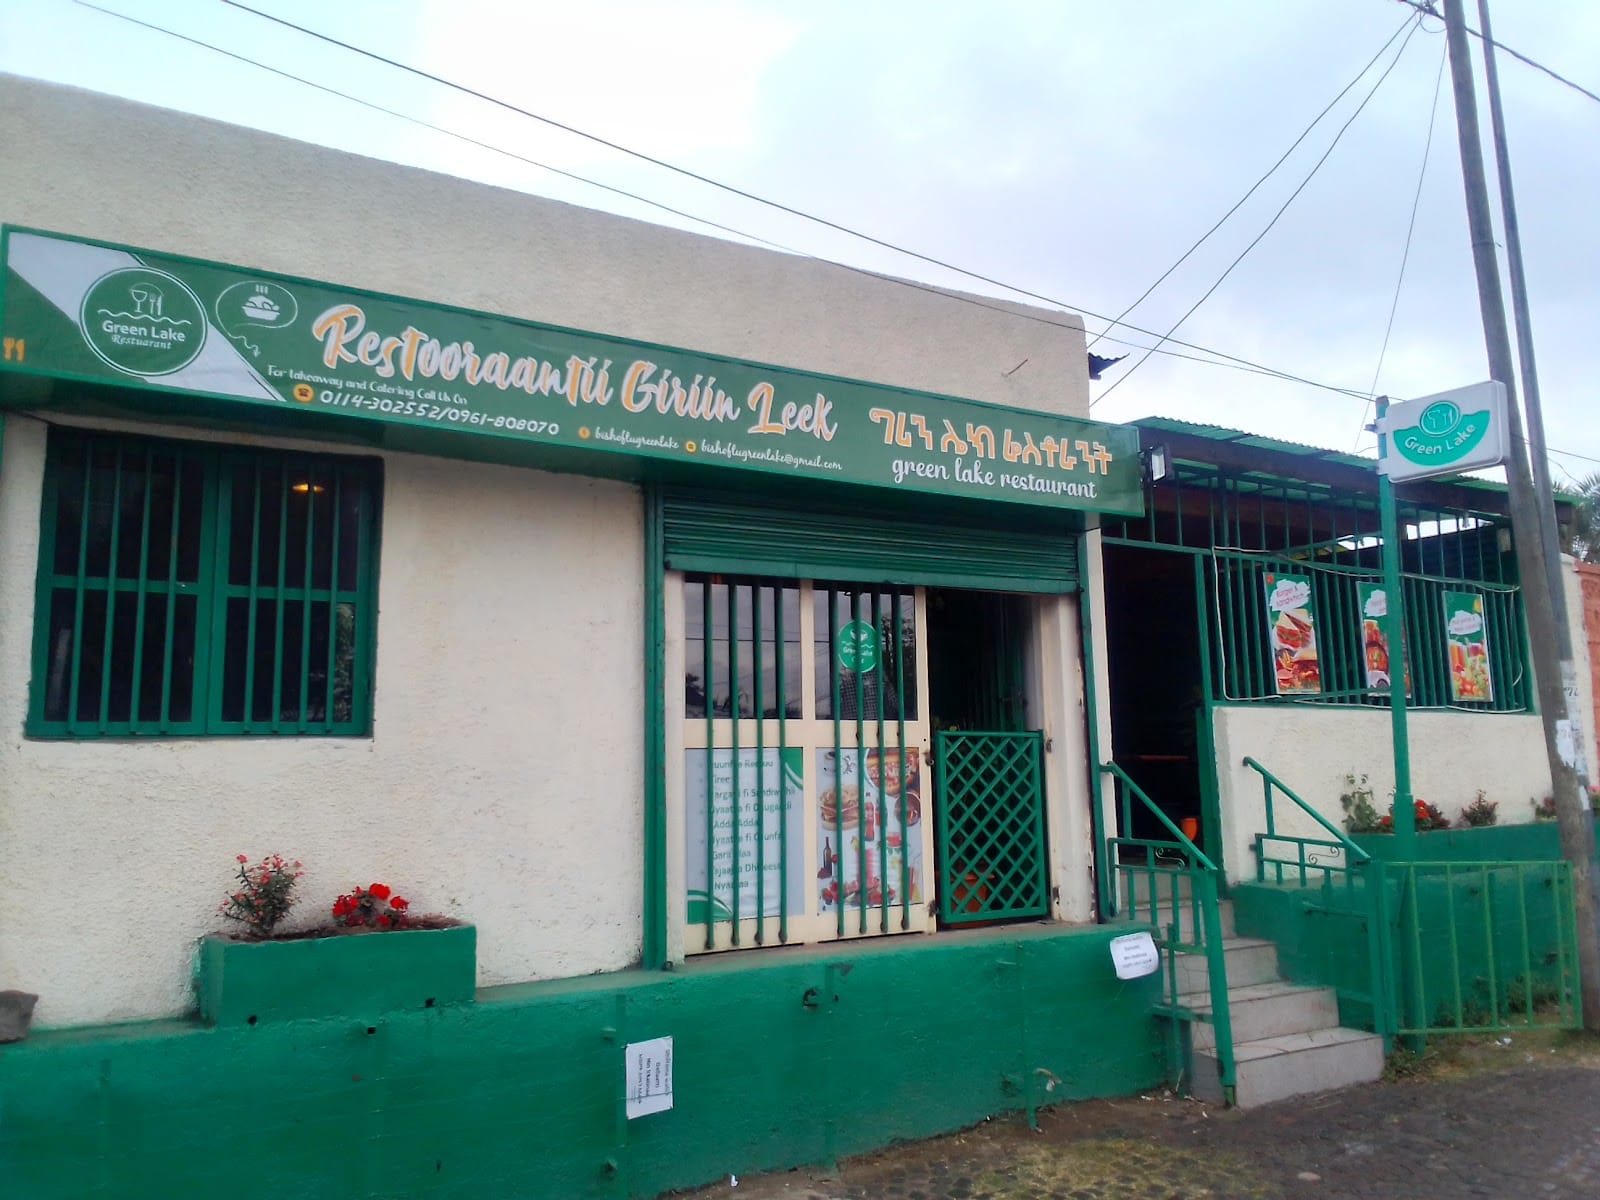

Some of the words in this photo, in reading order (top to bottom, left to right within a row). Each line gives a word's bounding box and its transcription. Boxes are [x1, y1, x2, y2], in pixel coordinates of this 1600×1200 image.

[102, 320, 147, 337] Green
[151, 326, 186, 342] Lake
[268, 364, 288, 377] For
[345, 381, 367, 390] and
[369, 381, 415, 400] Catering
[417, 388, 437, 400] Call
[438, 391, 452, 402] Us
[453, 393, 468, 405] On
[312, 304, 613, 406] Restooraantii
[621, 360, 740, 422] Giriin
[747, 382, 838, 441] Leek
[320, 390, 559, 435] 0114-302552/0961-808070
[1404, 436, 1443, 455] Green
[1445, 424, 1476, 450] Lake
[892, 459, 950, 484] green
[954, 457, 996, 487] lake
[1000, 472, 1098, 499] restaurant
